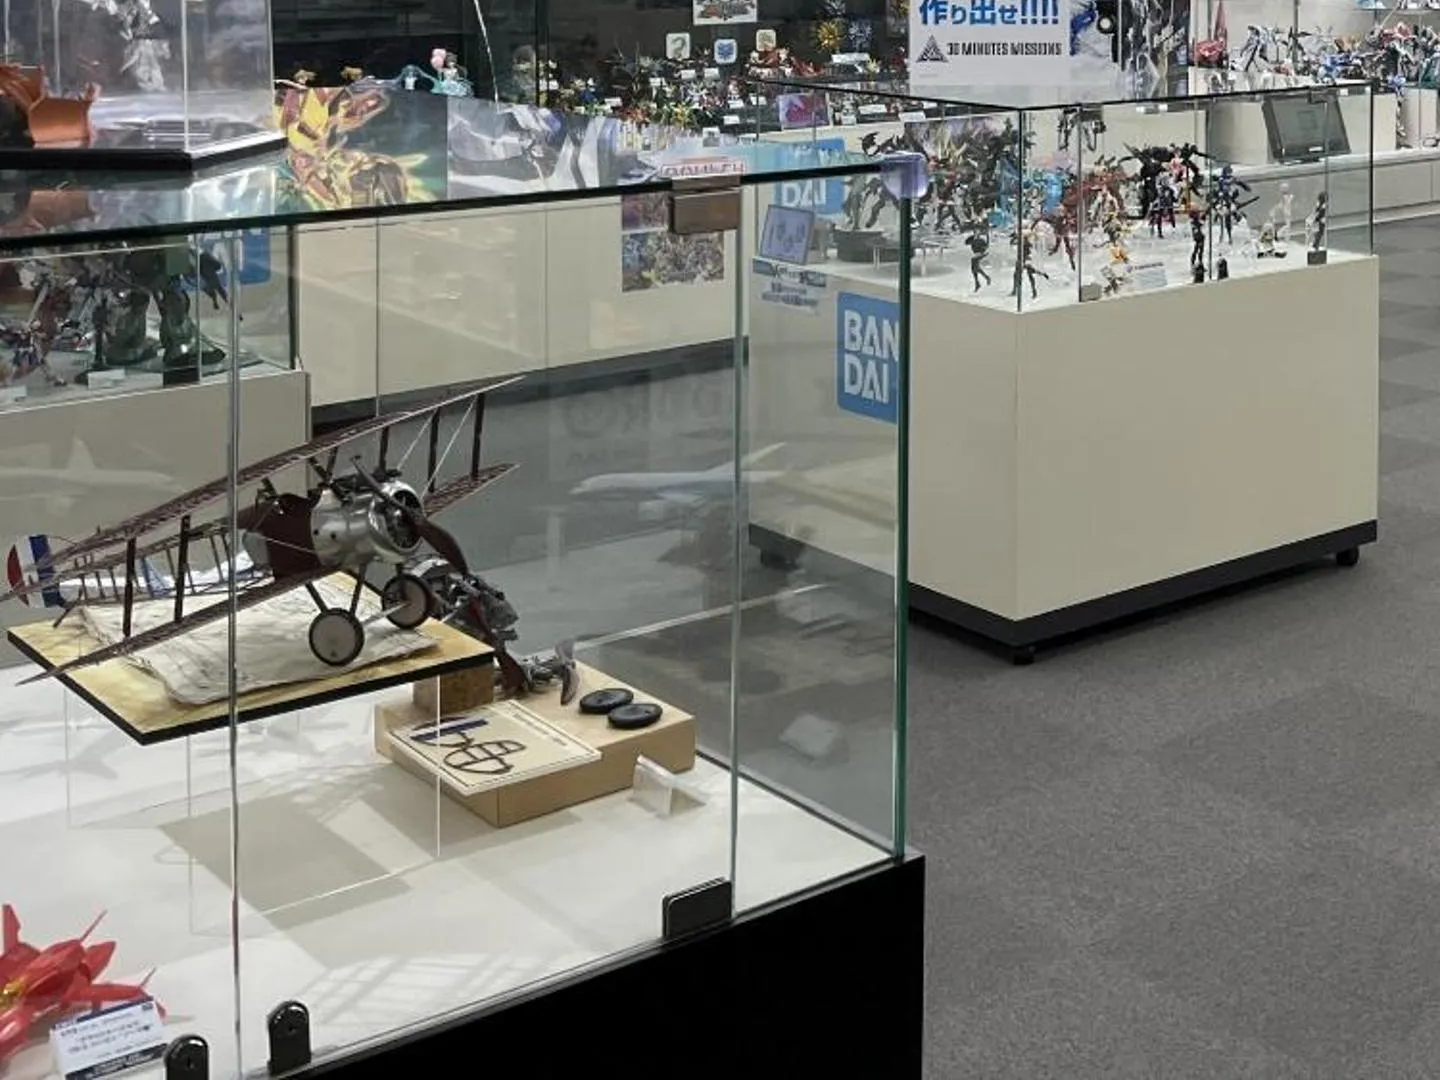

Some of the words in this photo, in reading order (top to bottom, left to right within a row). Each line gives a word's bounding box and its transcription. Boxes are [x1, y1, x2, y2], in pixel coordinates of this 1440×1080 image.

[961, 42, 1008, 56] MINUTES
[1010, 42, 1062, 56] MISSIONS
[844, 308, 899, 362] BAN
[844, 353, 889, 404] DAI
